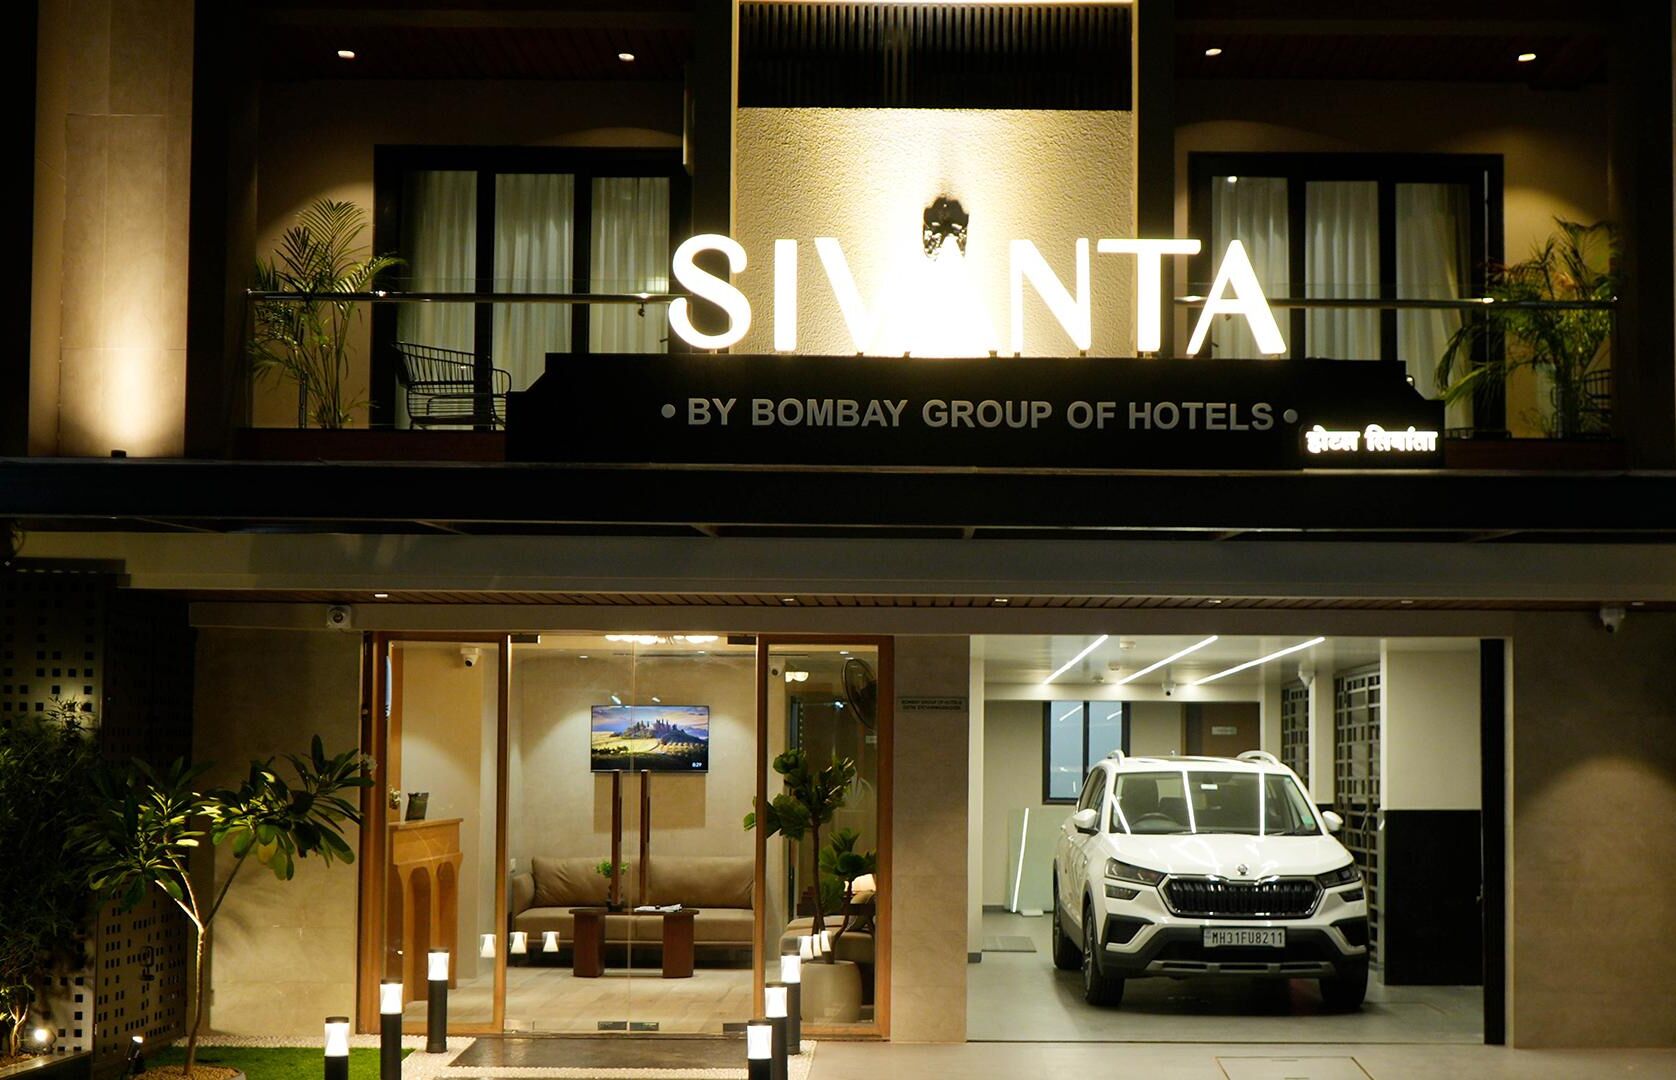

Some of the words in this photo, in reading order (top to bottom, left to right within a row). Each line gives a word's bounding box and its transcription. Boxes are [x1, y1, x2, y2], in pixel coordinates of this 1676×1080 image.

[688, 397, 737, 425] BY
[752, 398, 908, 427] BOMBAY
[922, 399, 1052, 428] GROUP
[1067, 400, 1116, 429] OF
[1129, 401, 1274, 430] HOTELS
[1212, 931, 1283, 944] MH31FU8211
